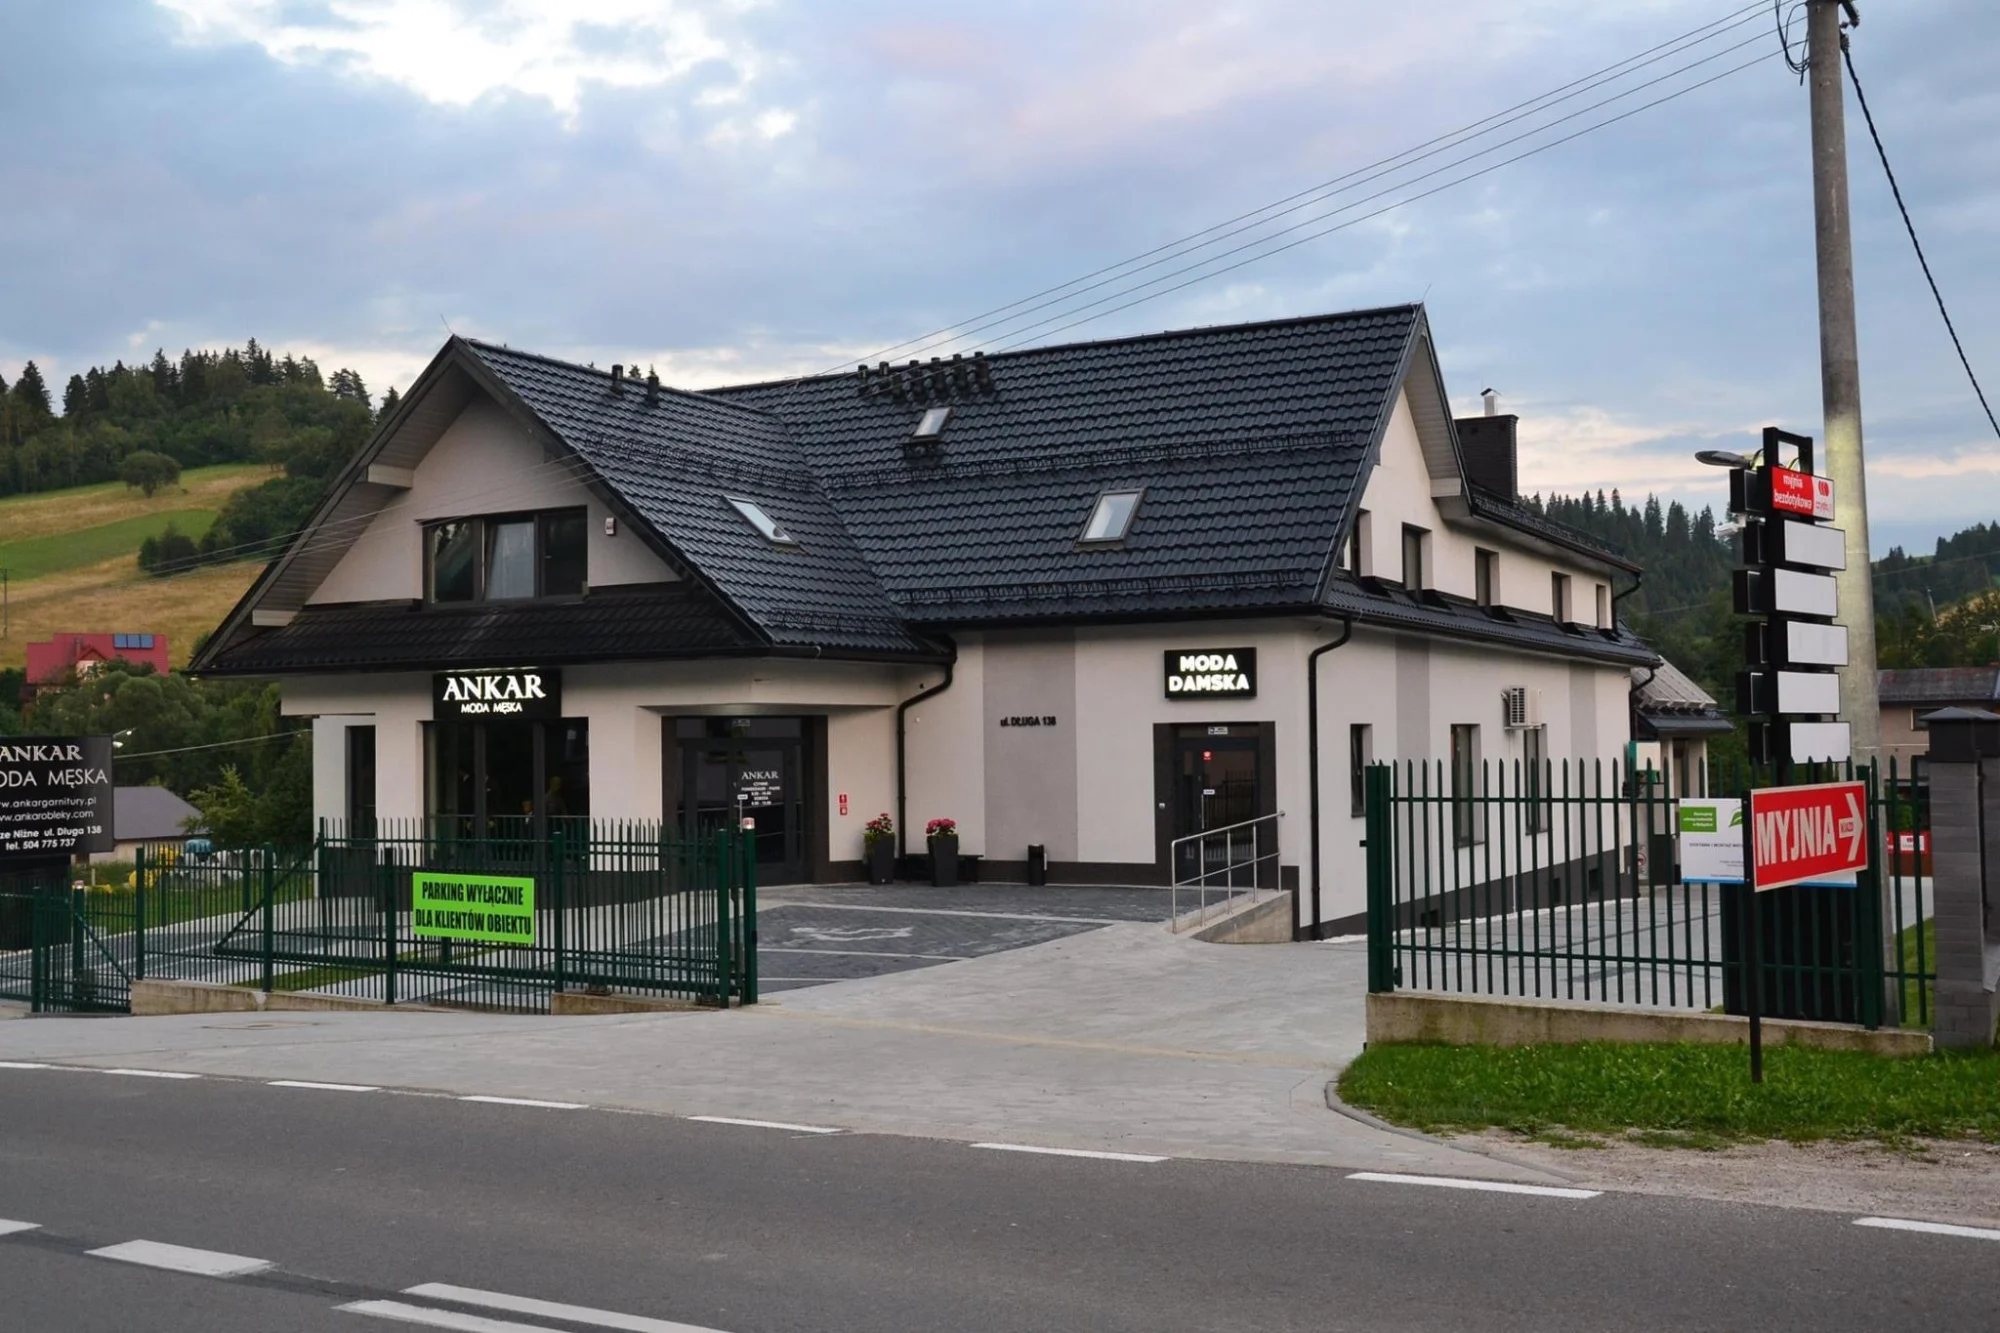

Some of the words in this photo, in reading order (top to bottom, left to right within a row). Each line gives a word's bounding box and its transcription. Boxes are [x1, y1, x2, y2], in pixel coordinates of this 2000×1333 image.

[1783, 474, 1803, 489] myjnia
[1180, 654, 1238, 672] MODA
[443, 675, 547, 701] ANKAR
[1169, 673, 1250, 692] DAMSKA
[461, 702, 490, 713] MODA
[493, 702, 523, 715] MĘSKA
[1042, 716, 1057, 727] 138
[0, 744, 83, 762] ANKAR
[0, 770, 37, 788] ODA
[48, 768, 108, 789] MĘSKA
[741, 771, 779, 780] ANKAR
[0, 796, 97, 809] w.ankargarnitury.pl
[44, 828, 55, 837] ul.
[87, 825, 102, 835] 138
[1756, 805, 1836, 867] MYJNIA
[6, 842, 20, 851] tel.
[23, 841, 39, 850] 504
[41, 839, 58, 849] 775
[60, 838, 76, 848] 737
[422, 881, 464, 902] PARKING
[466, 883, 524, 907] WYŁĄCZNIE
[415, 908, 433, 928] DLA
[434, 909, 485, 932] KLIENTÓW
[487, 913, 532, 935] OBIEKTU
